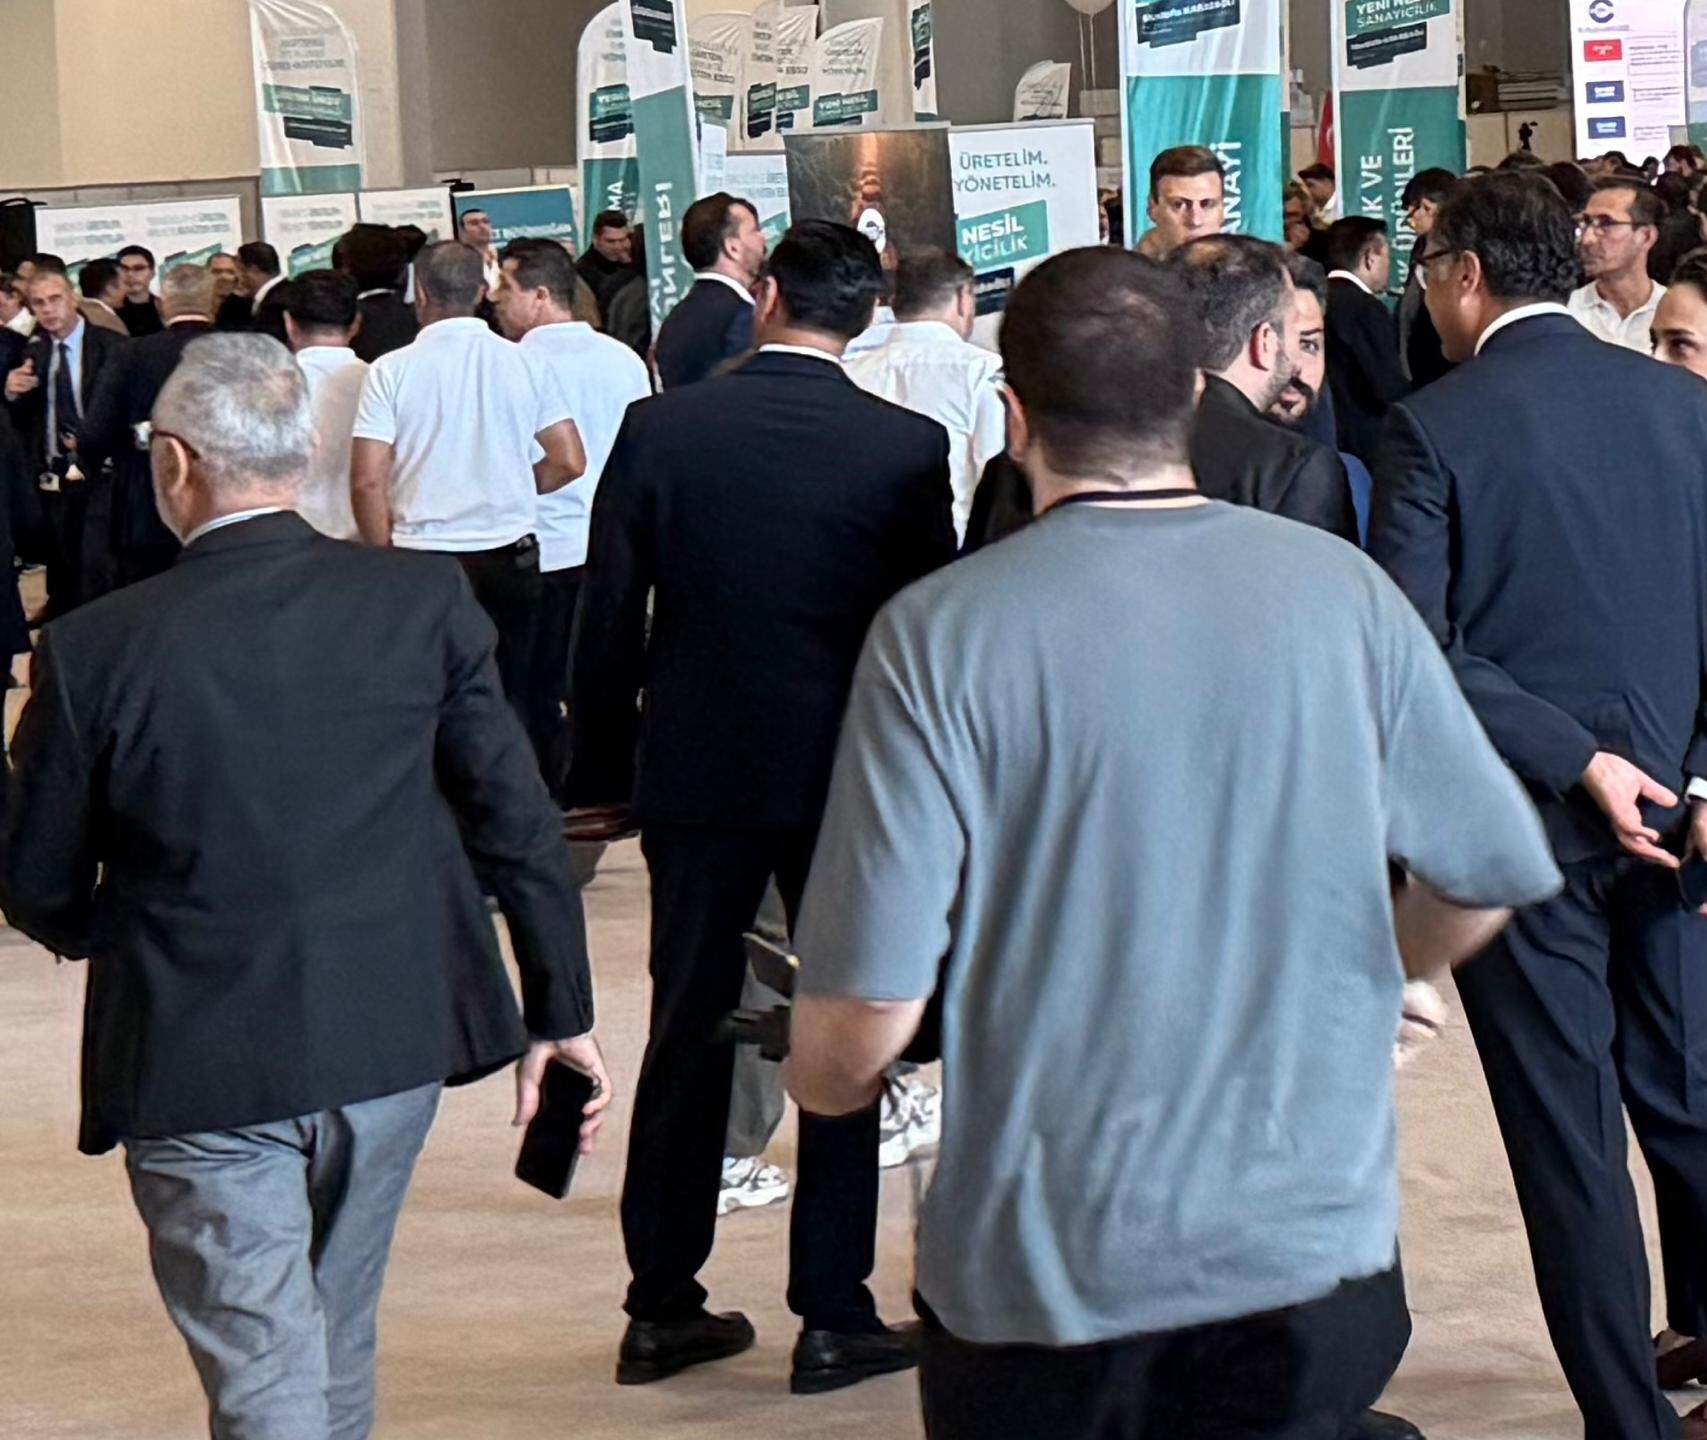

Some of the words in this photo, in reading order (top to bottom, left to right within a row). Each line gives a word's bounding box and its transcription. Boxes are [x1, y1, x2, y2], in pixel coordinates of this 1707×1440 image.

[959, 148, 1048, 170] ÜRETELİM.
[1361, 155, 1383, 188] VE
[955, 170, 1056, 192] YÖNETELİM.
[1209, 141, 1242, 236] ANAYİ
[961, 213, 1025, 246] NESİL
